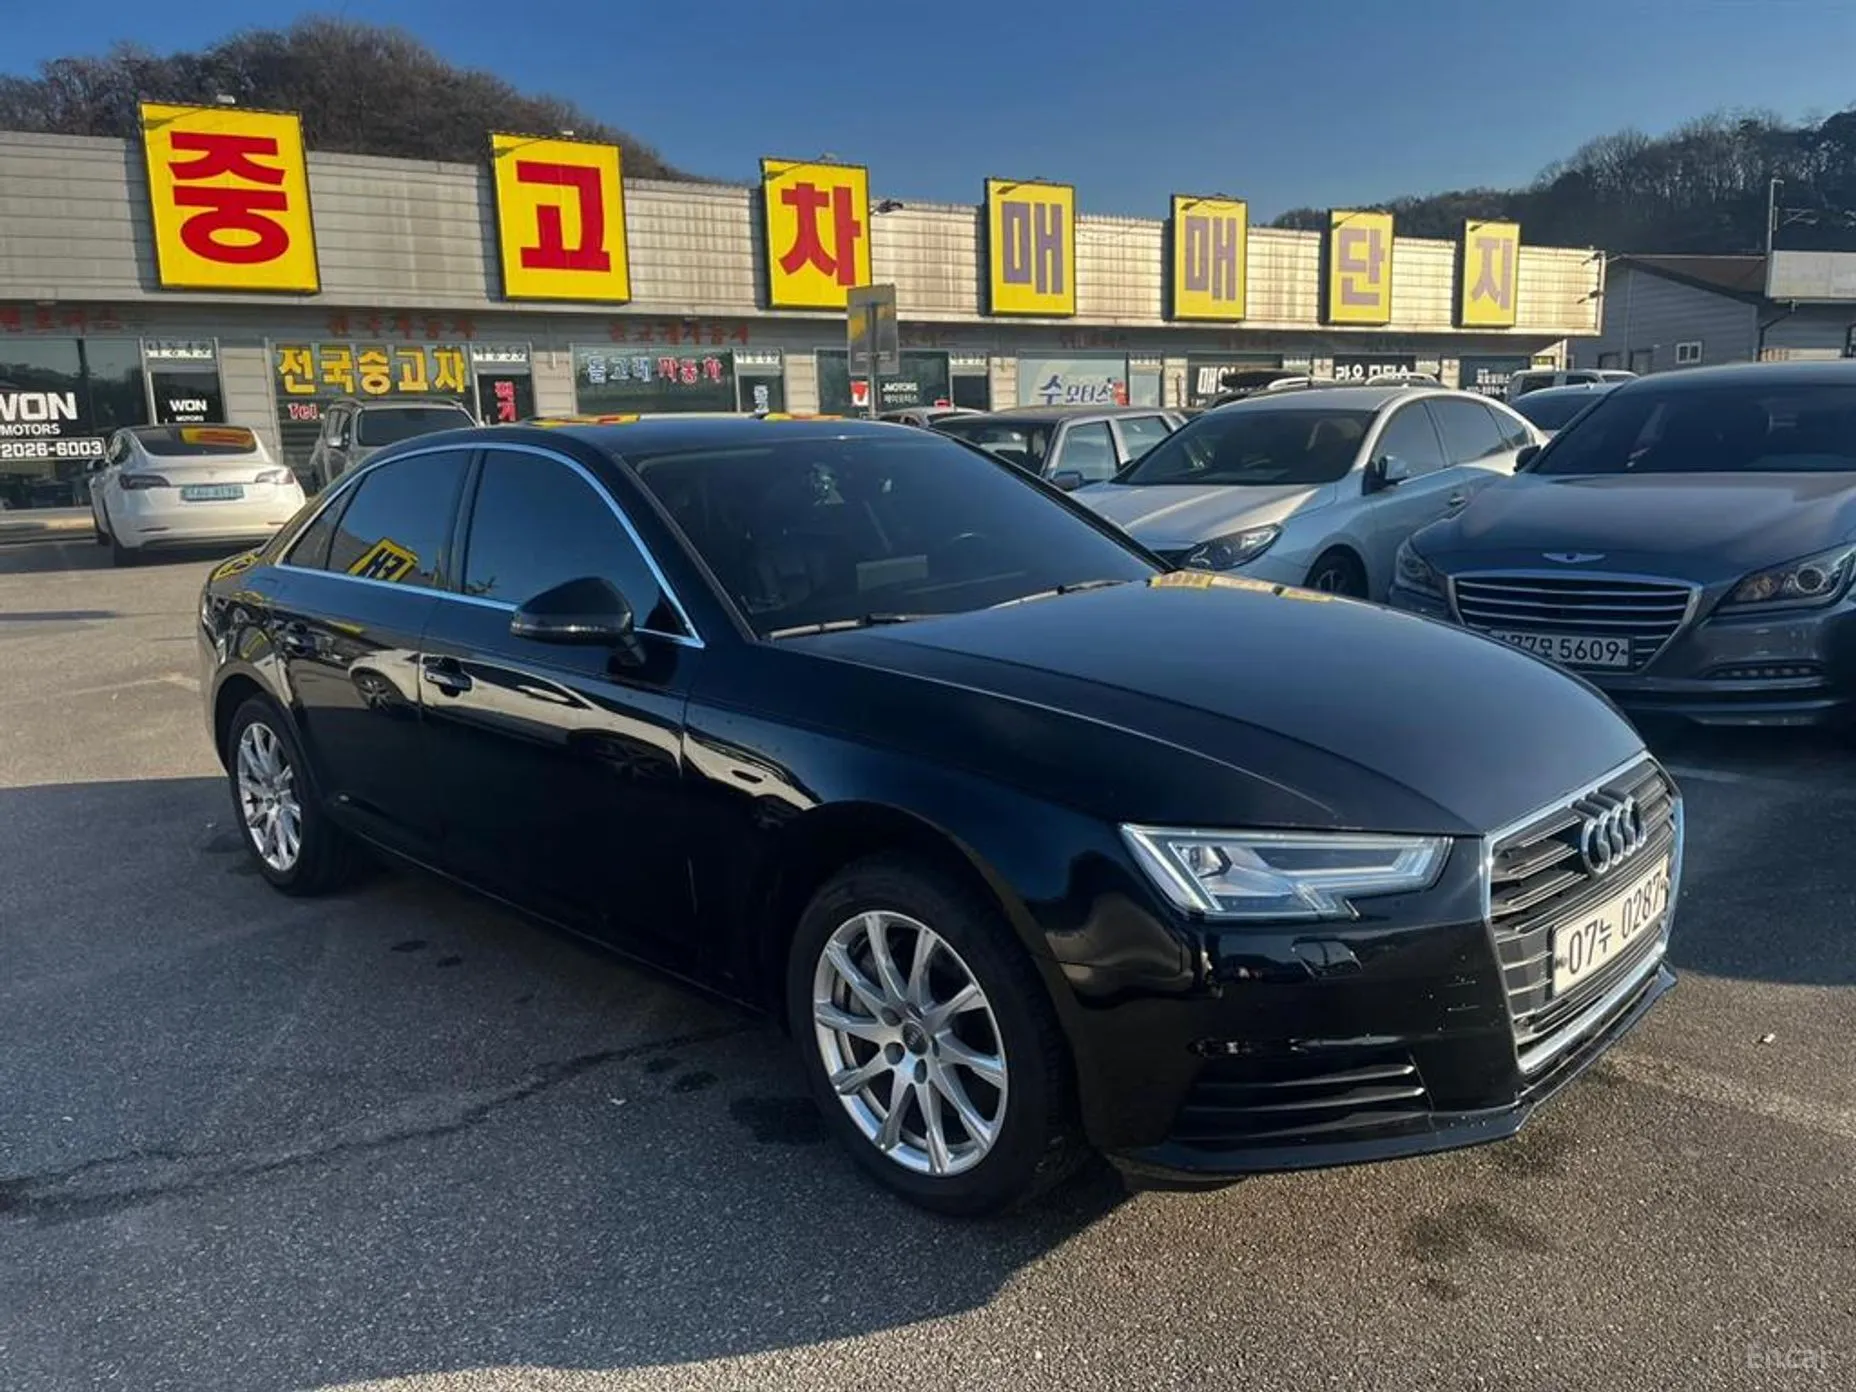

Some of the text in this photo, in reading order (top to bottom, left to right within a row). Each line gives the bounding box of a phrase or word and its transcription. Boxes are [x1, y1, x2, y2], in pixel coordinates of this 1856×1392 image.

[168, 130, 1513, 310] 중 고 차 매 매 단 지
[1038, 374, 1062, 406] 수
[169, 399, 208, 412] WON
[1, 441, 103, 458] 2026-6003
[1559, 638, 1620, 661] 5609
[1568, 872, 1662, 975] 07누 0287
